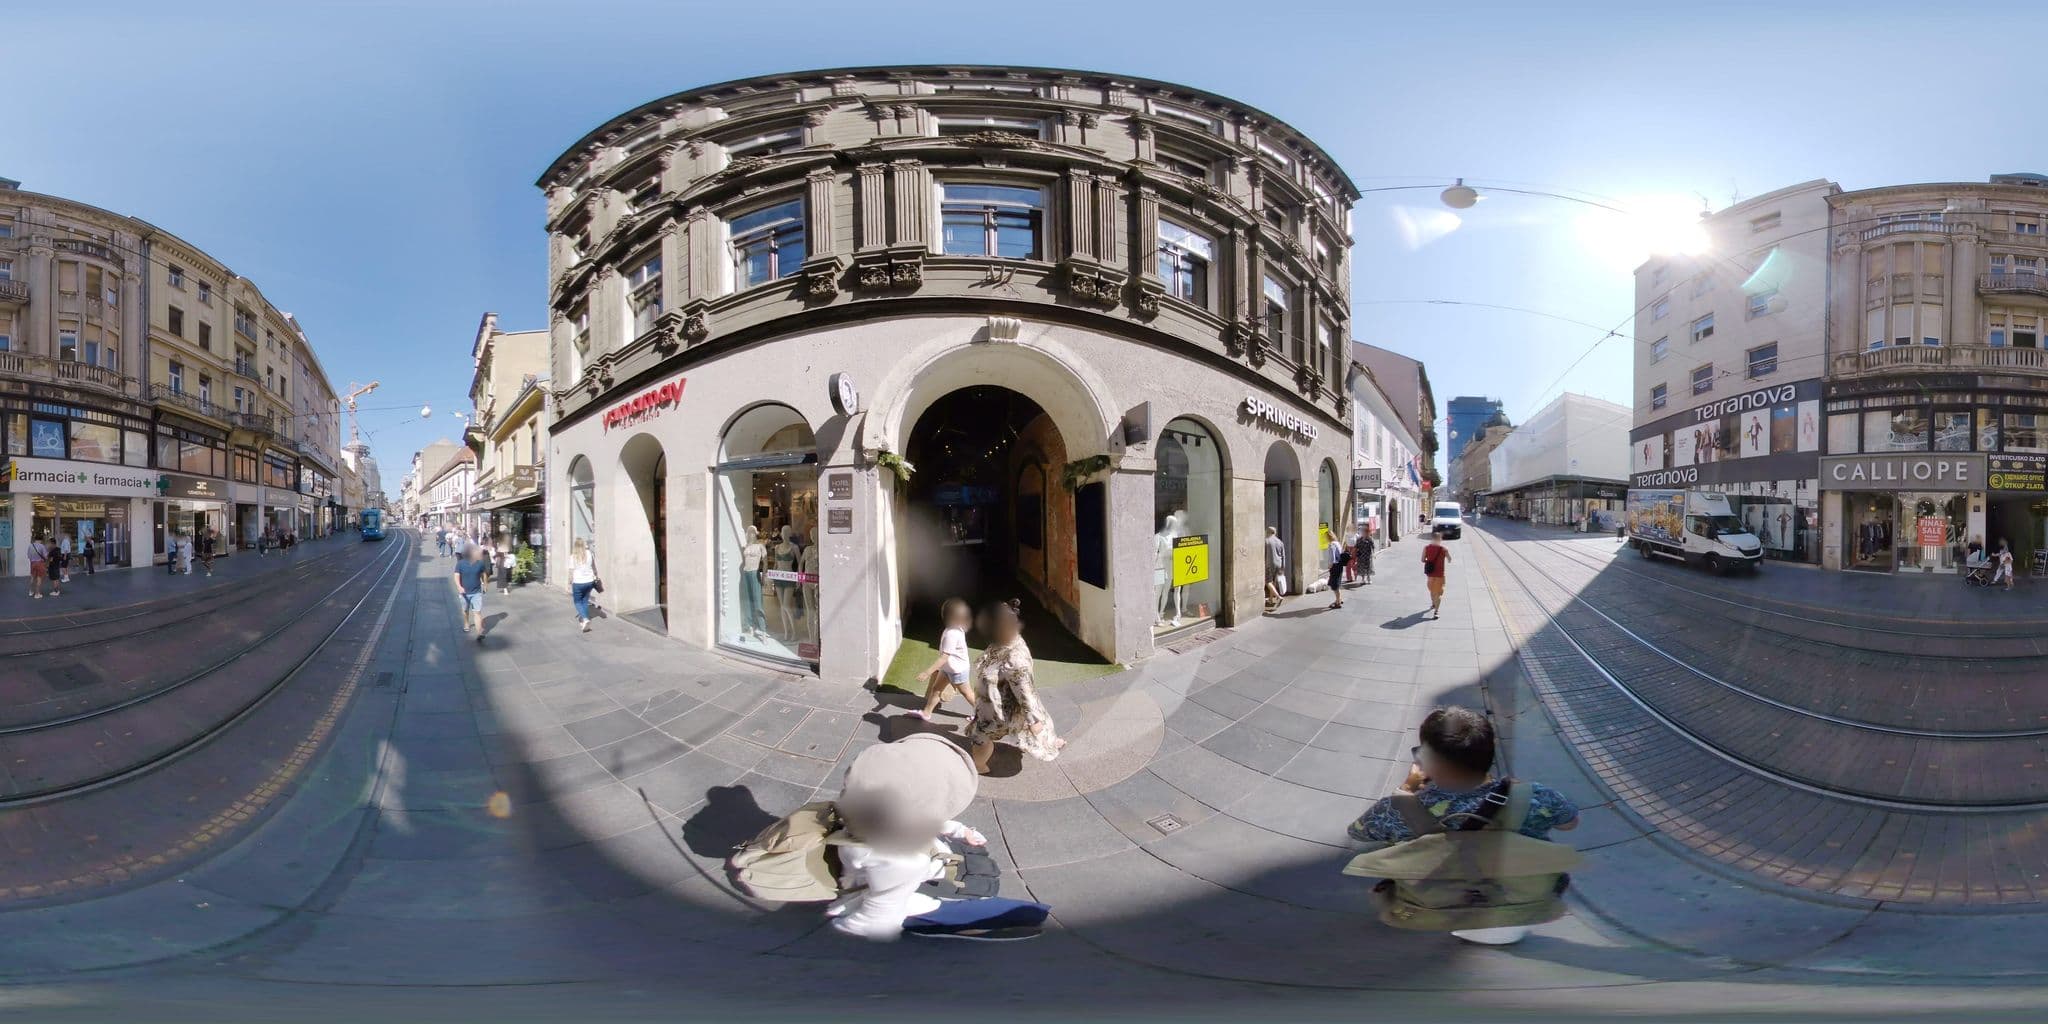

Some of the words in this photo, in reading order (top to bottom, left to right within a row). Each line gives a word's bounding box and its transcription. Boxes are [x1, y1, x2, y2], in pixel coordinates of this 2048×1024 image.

[603, 378, 687, 434] yamamay
[1246, 396, 1318, 439] SPRINGFIELD
[16, 468, 76, 483] farmacia
[94, 473, 142, 488] farmacia
[1833, 461, 1968, 481] CALLIOPE
[1920, 519, 1945, 527] FINAL
